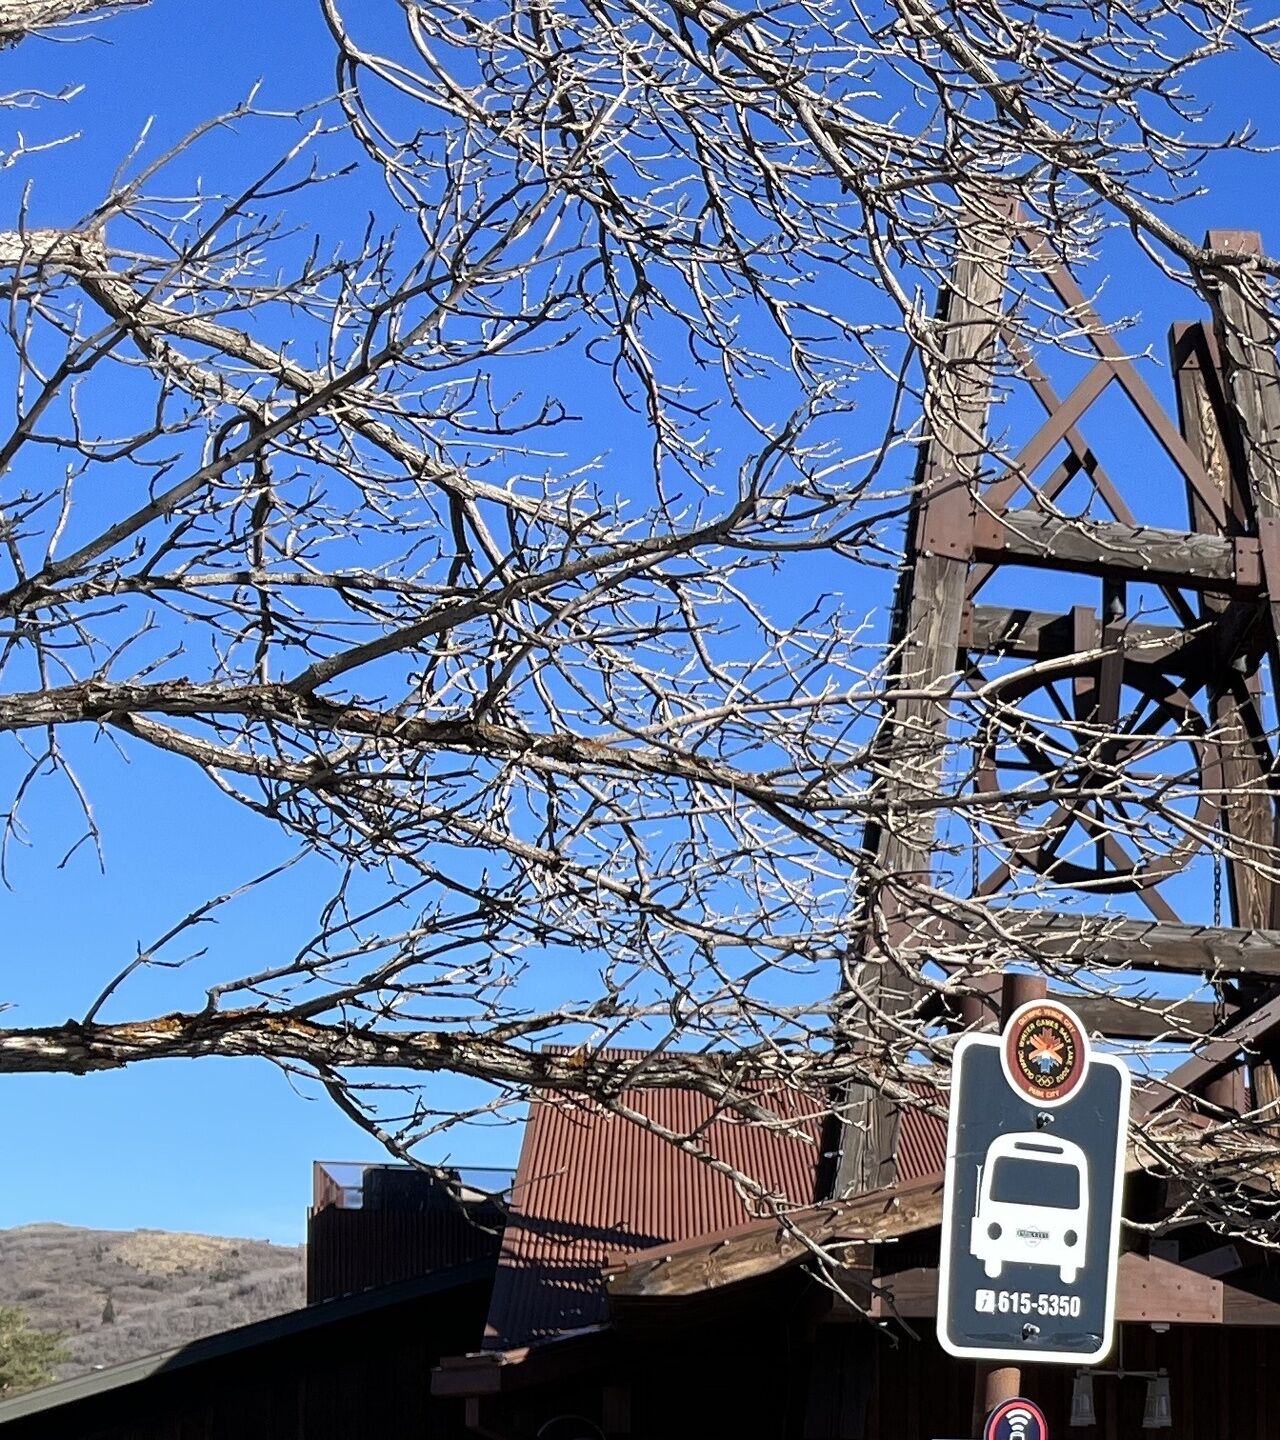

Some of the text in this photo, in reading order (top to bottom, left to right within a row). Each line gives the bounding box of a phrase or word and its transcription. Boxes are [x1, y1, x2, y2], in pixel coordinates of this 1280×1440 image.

[1036, 1019, 1059, 1030] GAMES
[1045, 1090, 1060, 1098] CITY
[998, 1291, 1081, 1317] 615-5350
